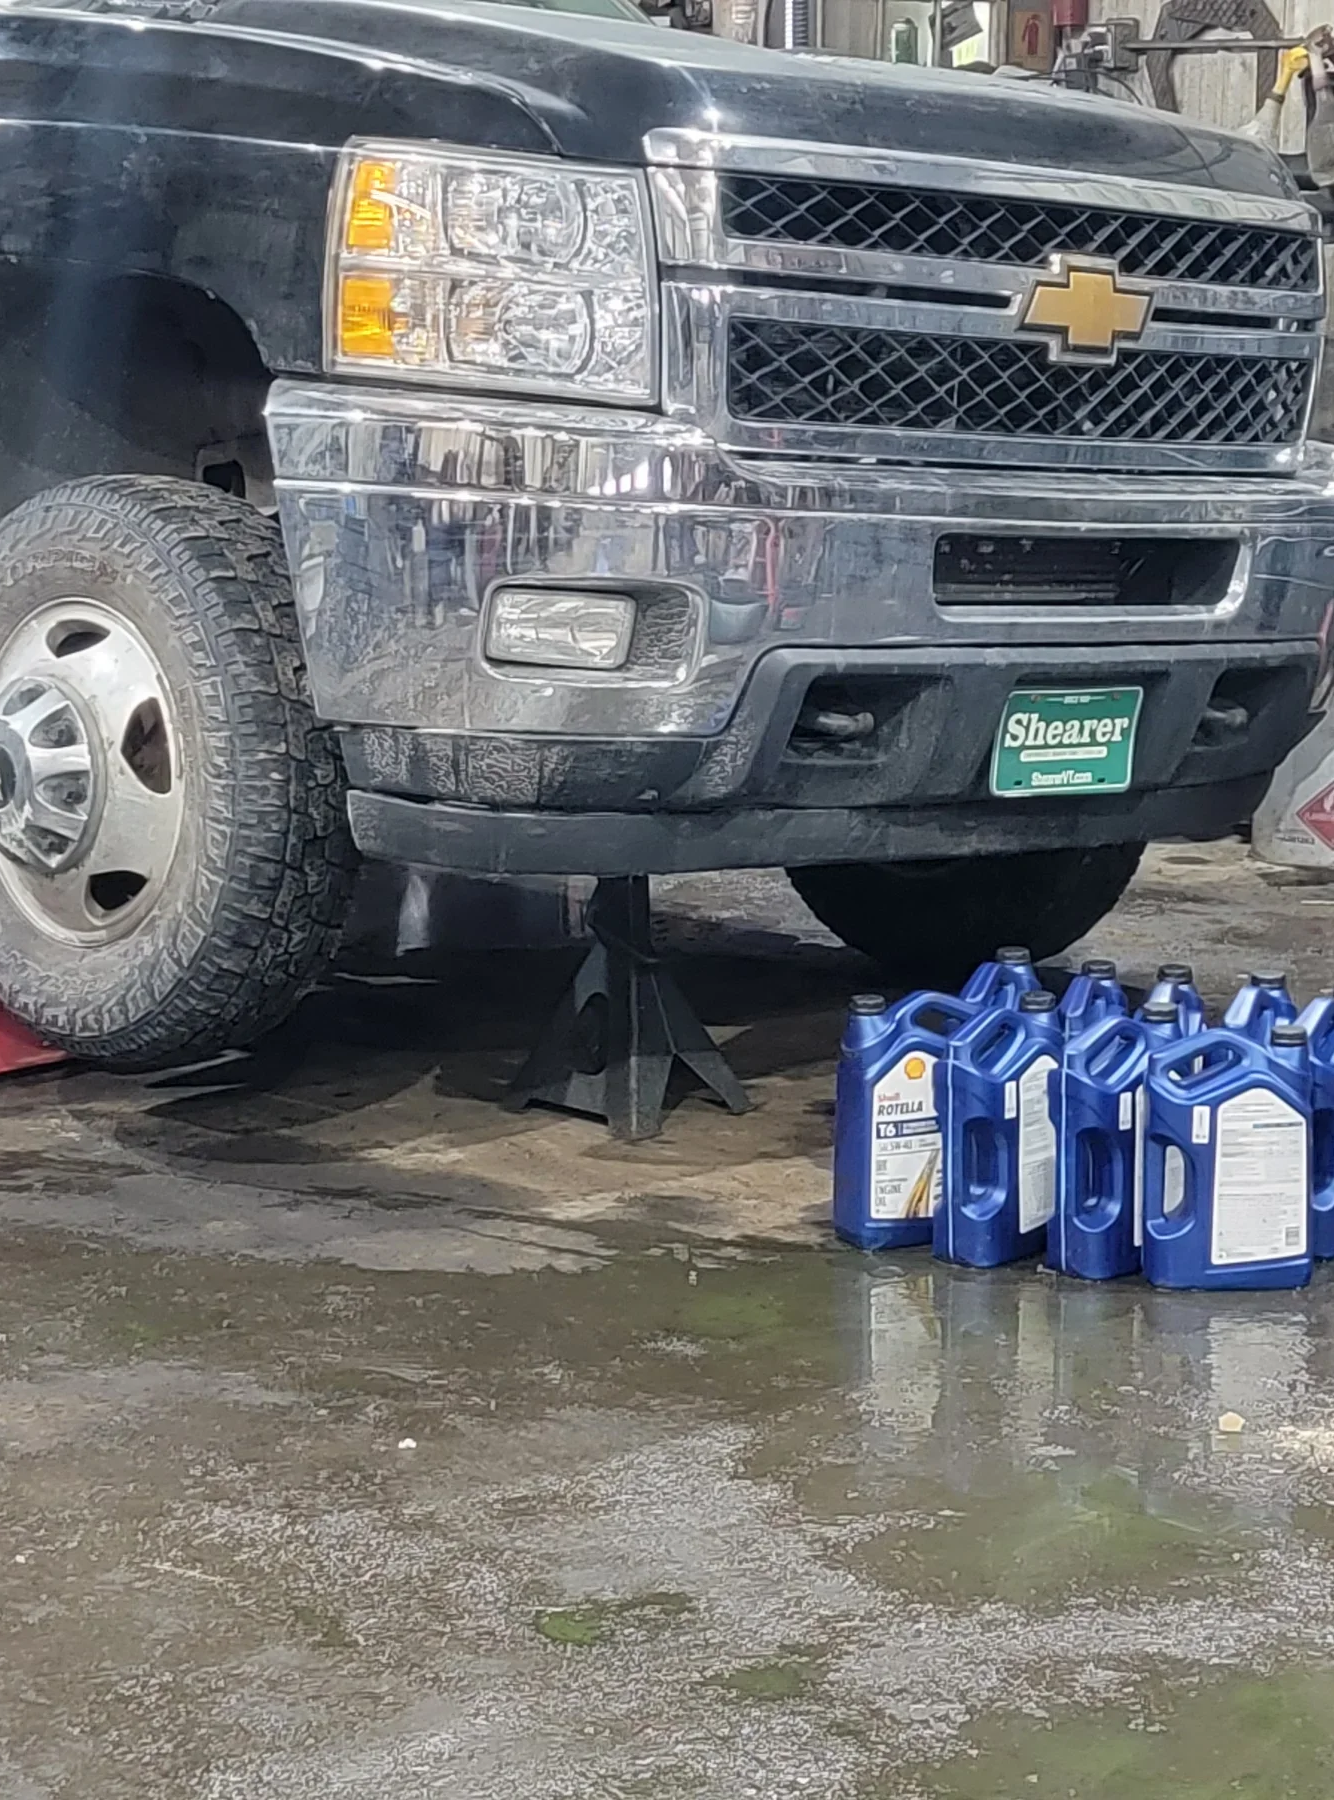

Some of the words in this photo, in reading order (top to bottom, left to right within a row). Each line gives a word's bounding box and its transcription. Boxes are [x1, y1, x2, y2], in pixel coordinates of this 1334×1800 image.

[1004, 712, 1130, 747] Shearer
[877, 1101, 924, 1116] ROTELLA
[878, 1123, 898, 1138] T6
